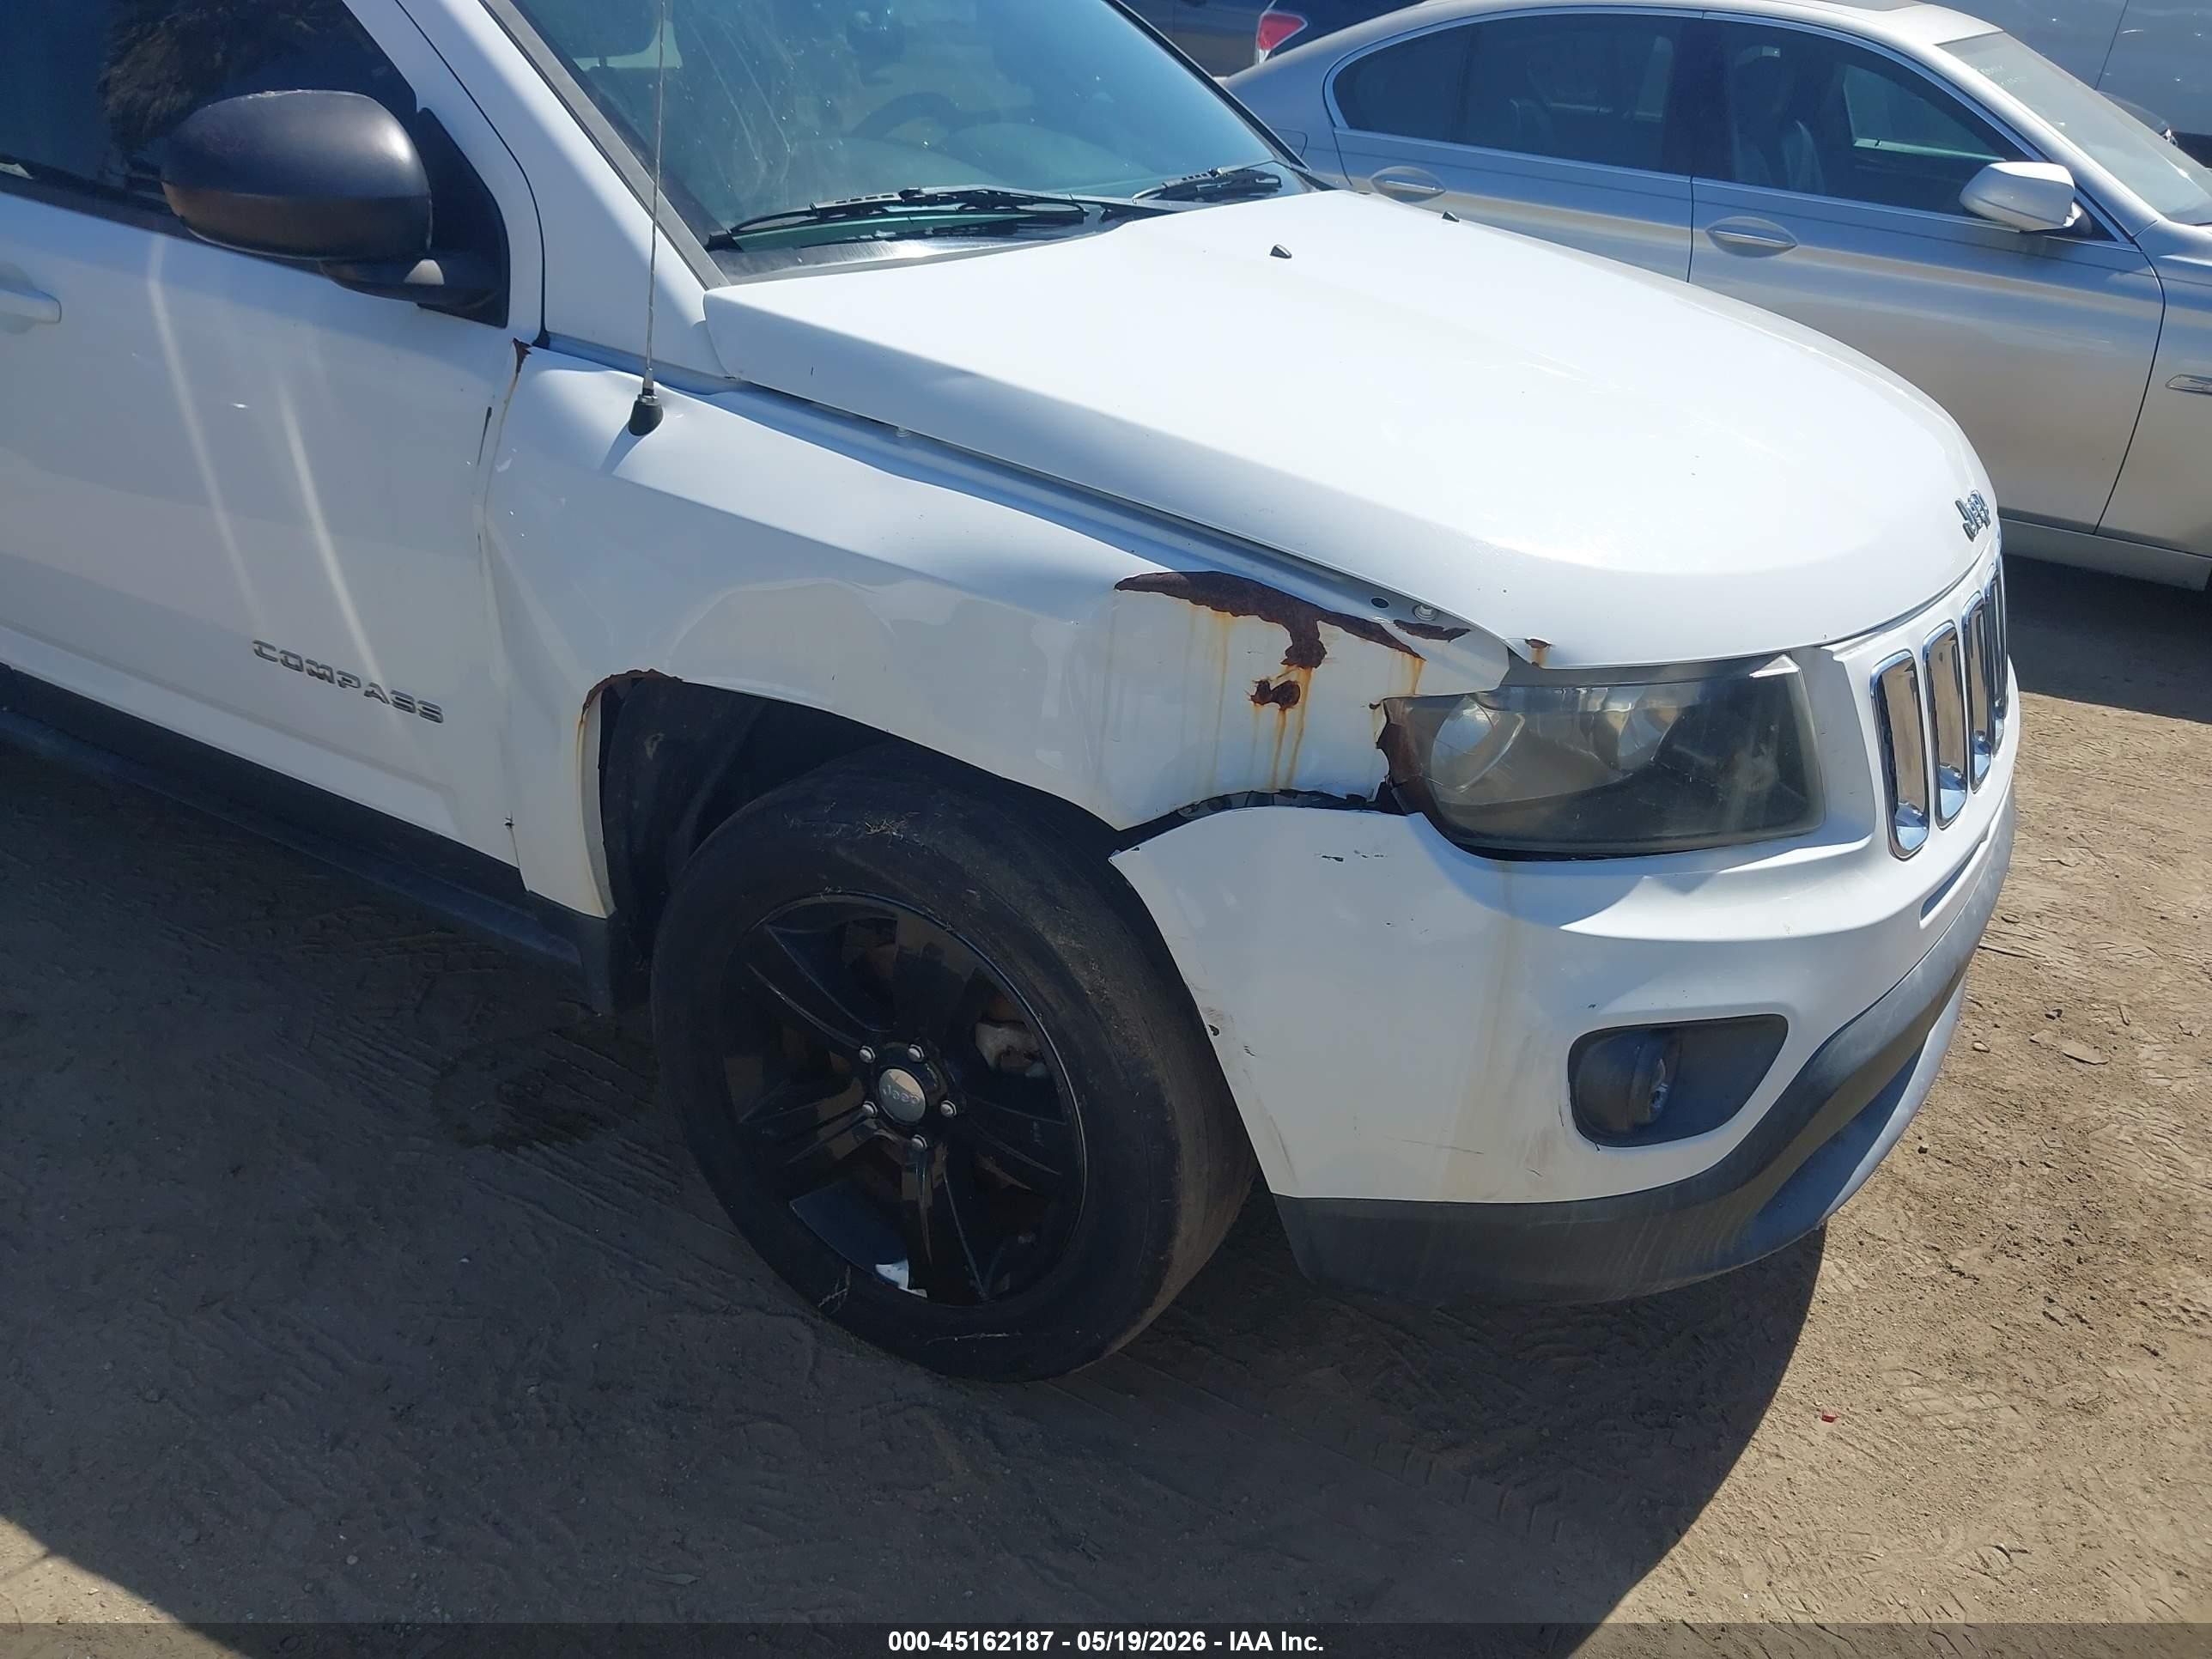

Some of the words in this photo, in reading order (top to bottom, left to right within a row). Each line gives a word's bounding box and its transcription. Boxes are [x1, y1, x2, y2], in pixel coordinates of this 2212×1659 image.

[1954, 489, 1991, 543] Jeep
[252, 639, 444, 724] COMPASS
[882, 1085, 921, 1107] Jeep
